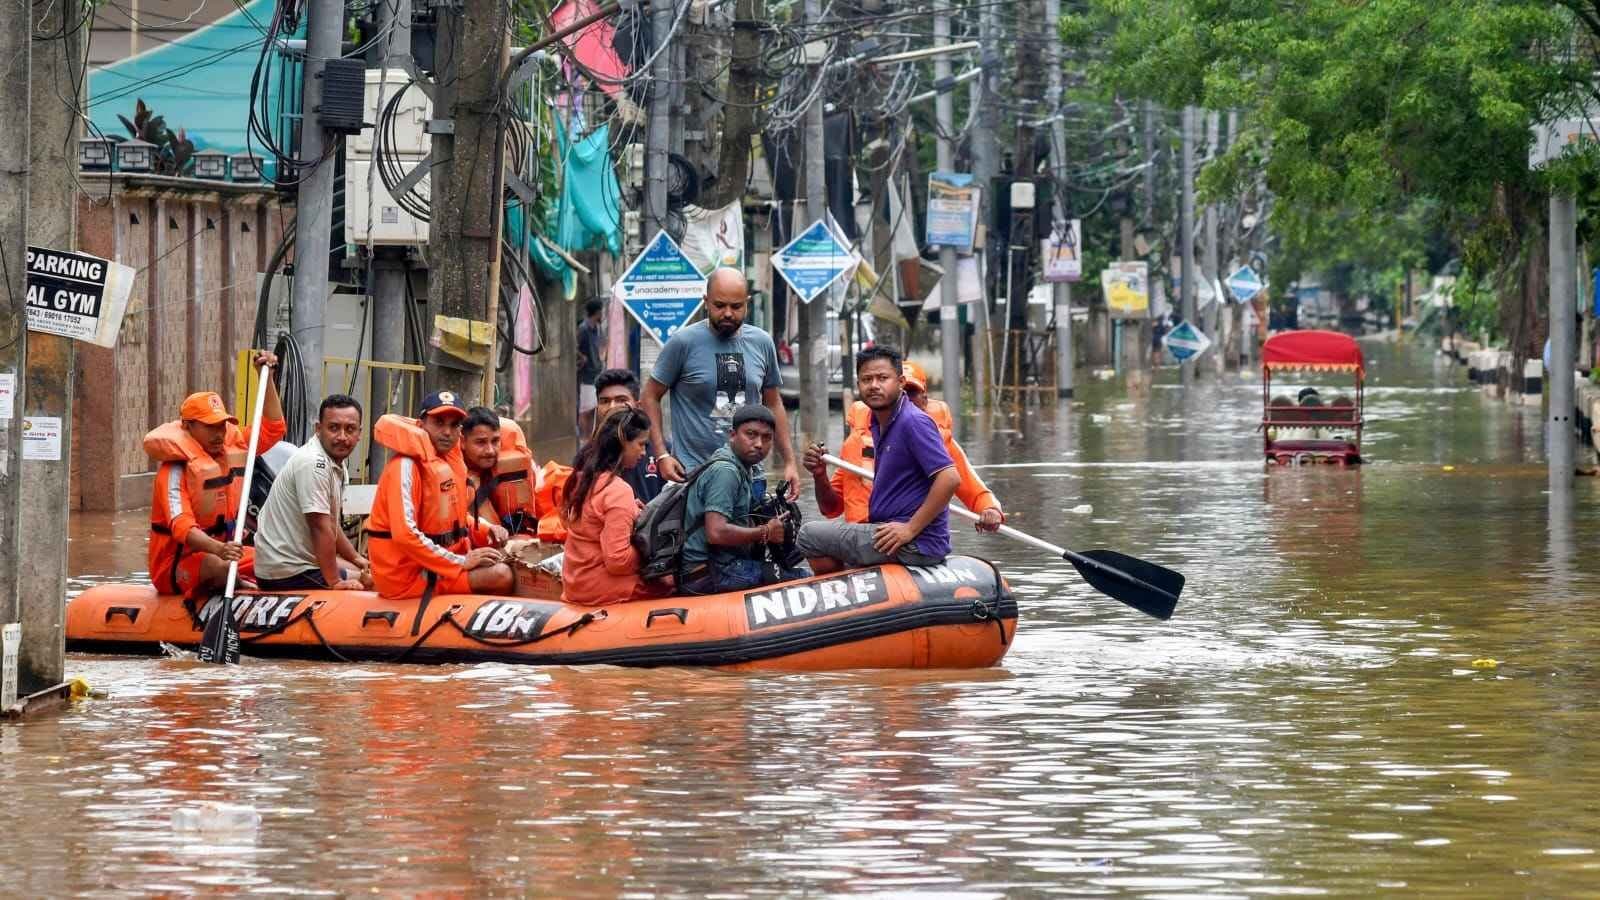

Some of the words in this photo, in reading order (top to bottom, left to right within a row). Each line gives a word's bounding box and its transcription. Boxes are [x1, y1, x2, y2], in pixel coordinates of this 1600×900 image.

[27, 252, 101, 280] PARKING
[54, 290, 96, 315] GYM
[635, 286, 679, 295] unacademy
[750, 571, 878, 624] NDRF
